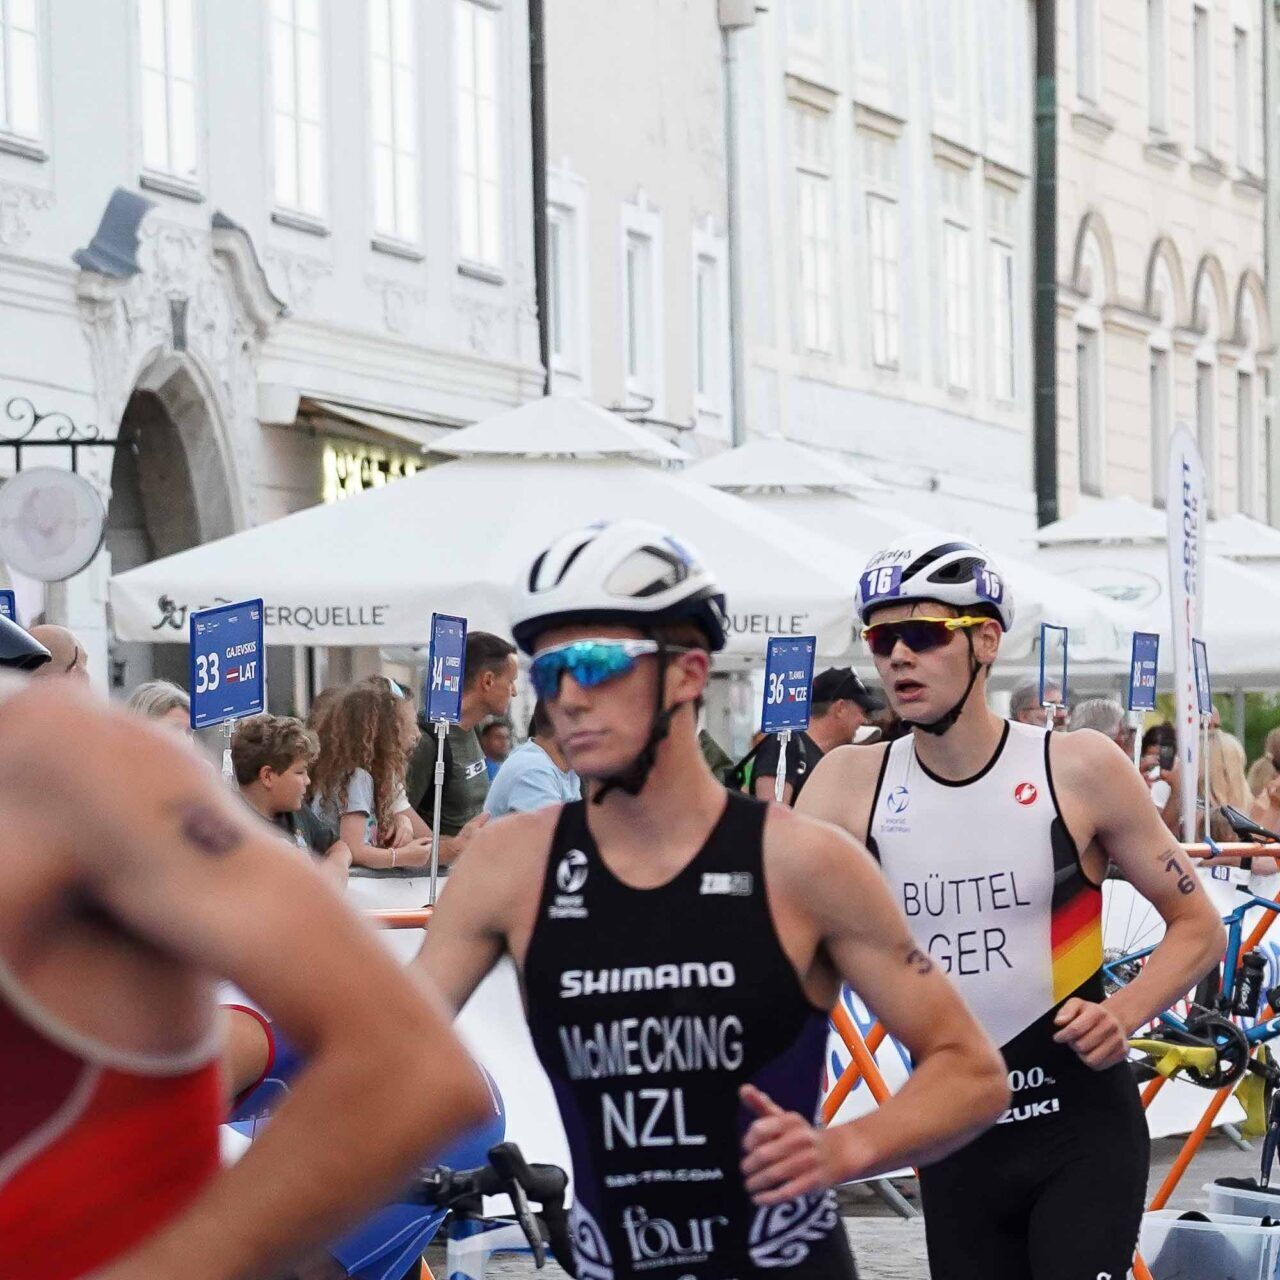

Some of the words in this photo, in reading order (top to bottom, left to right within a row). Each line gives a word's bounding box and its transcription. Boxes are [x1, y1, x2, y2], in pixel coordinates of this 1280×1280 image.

[867, 568, 893, 596] 16
[981, 570, 1000, 598] 16
[226, 641, 257, 659] GAJEVSKIS
[196, 652, 220, 694] 33
[239, 661, 257, 683] LAT
[767, 672, 785, 705] 36
[795, 686, 808, 702] CZE
[903, 871, 1031, 917] BÜTTEL
[1165, 857, 1196, 896] 16
[928, 927, 1014, 976] GER
[560, 961, 736, 998] SHIMANO
[558, 1014, 744, 1080] McMECKING
[602, 1087, 707, 1150] NZL
[622, 1204, 729, 1261] four
